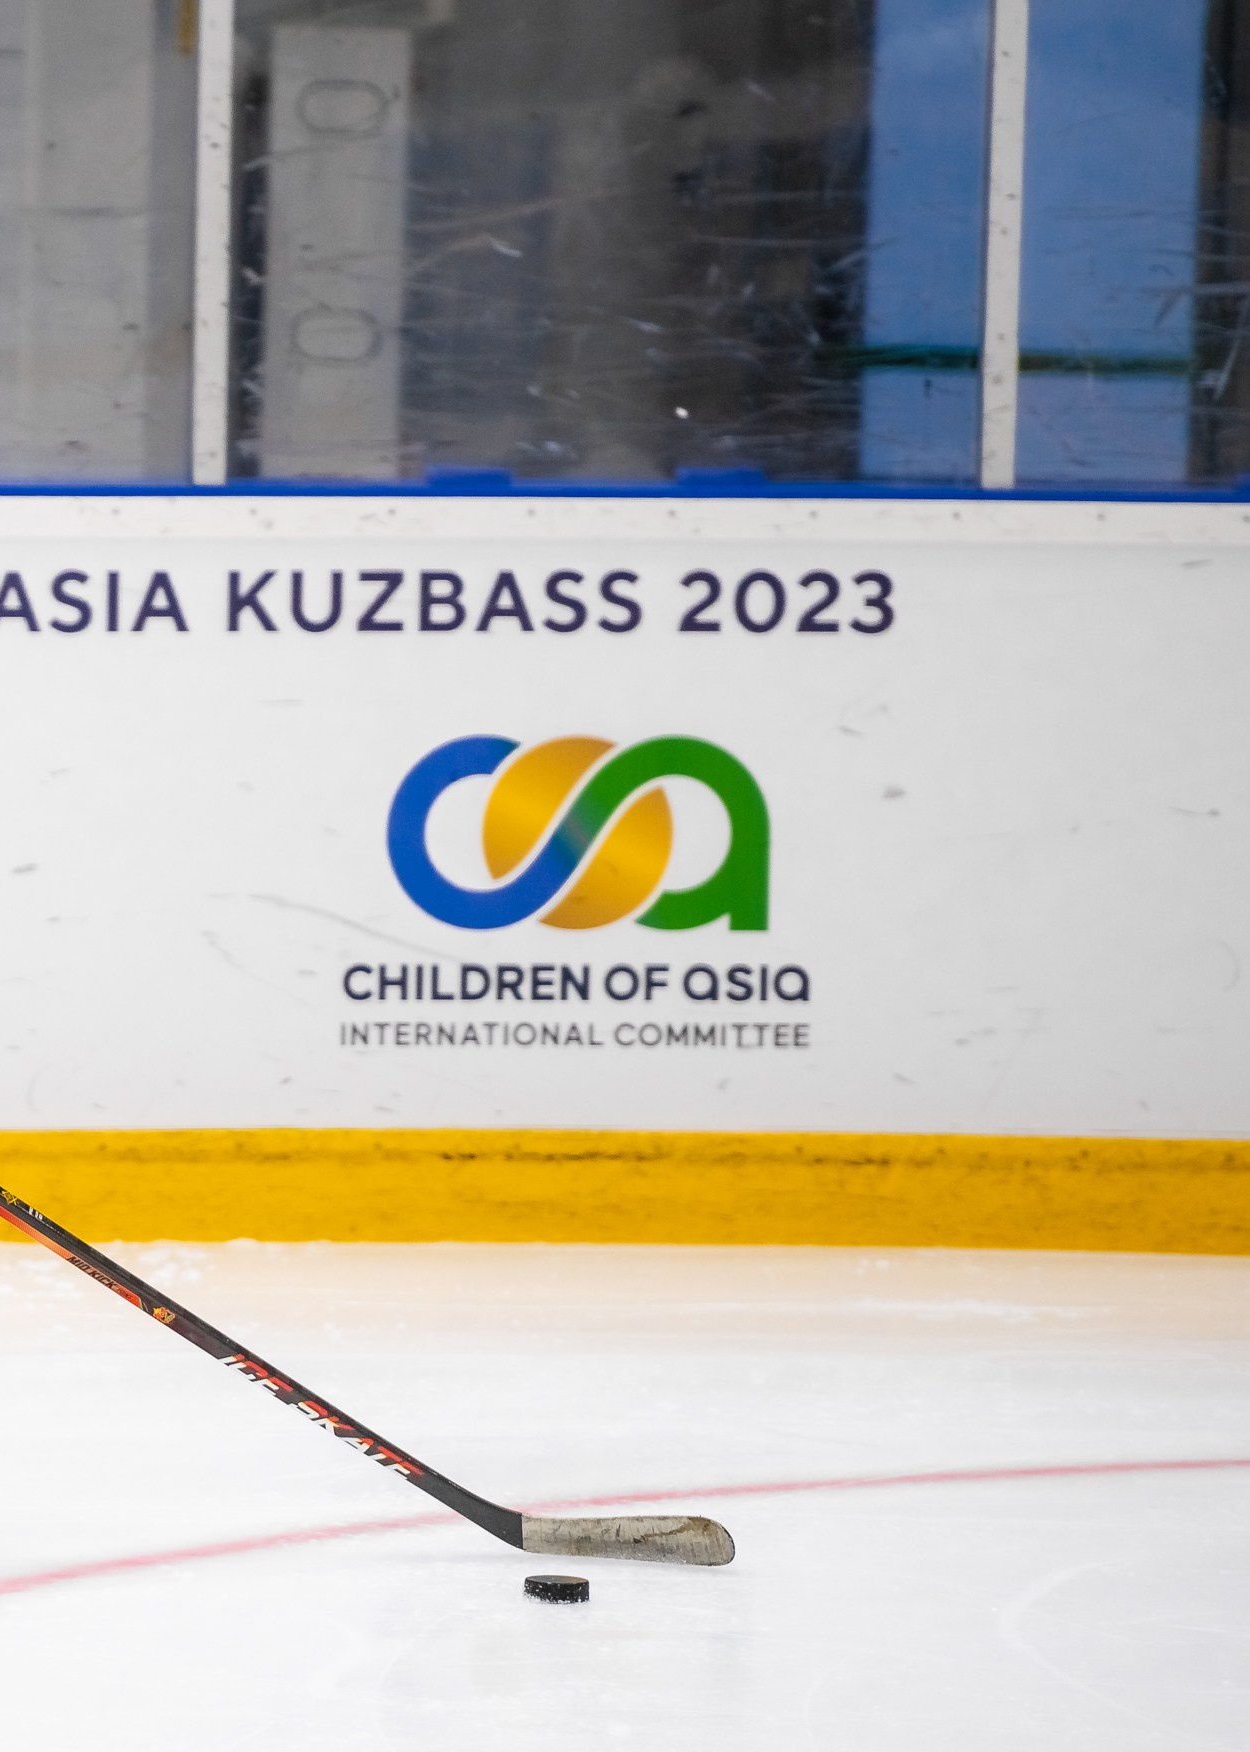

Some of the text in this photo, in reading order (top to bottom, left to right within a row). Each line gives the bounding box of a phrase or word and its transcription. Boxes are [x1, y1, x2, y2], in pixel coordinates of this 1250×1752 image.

[227, 569, 643, 635] KUZBASS
[677, 569, 896, 635] 2023
[343, 964, 590, 1001] CHILDREN
[603, 964, 670, 1001] OF
[341, 1022, 810, 1048] INTERNATIONAL COMMITTEE
